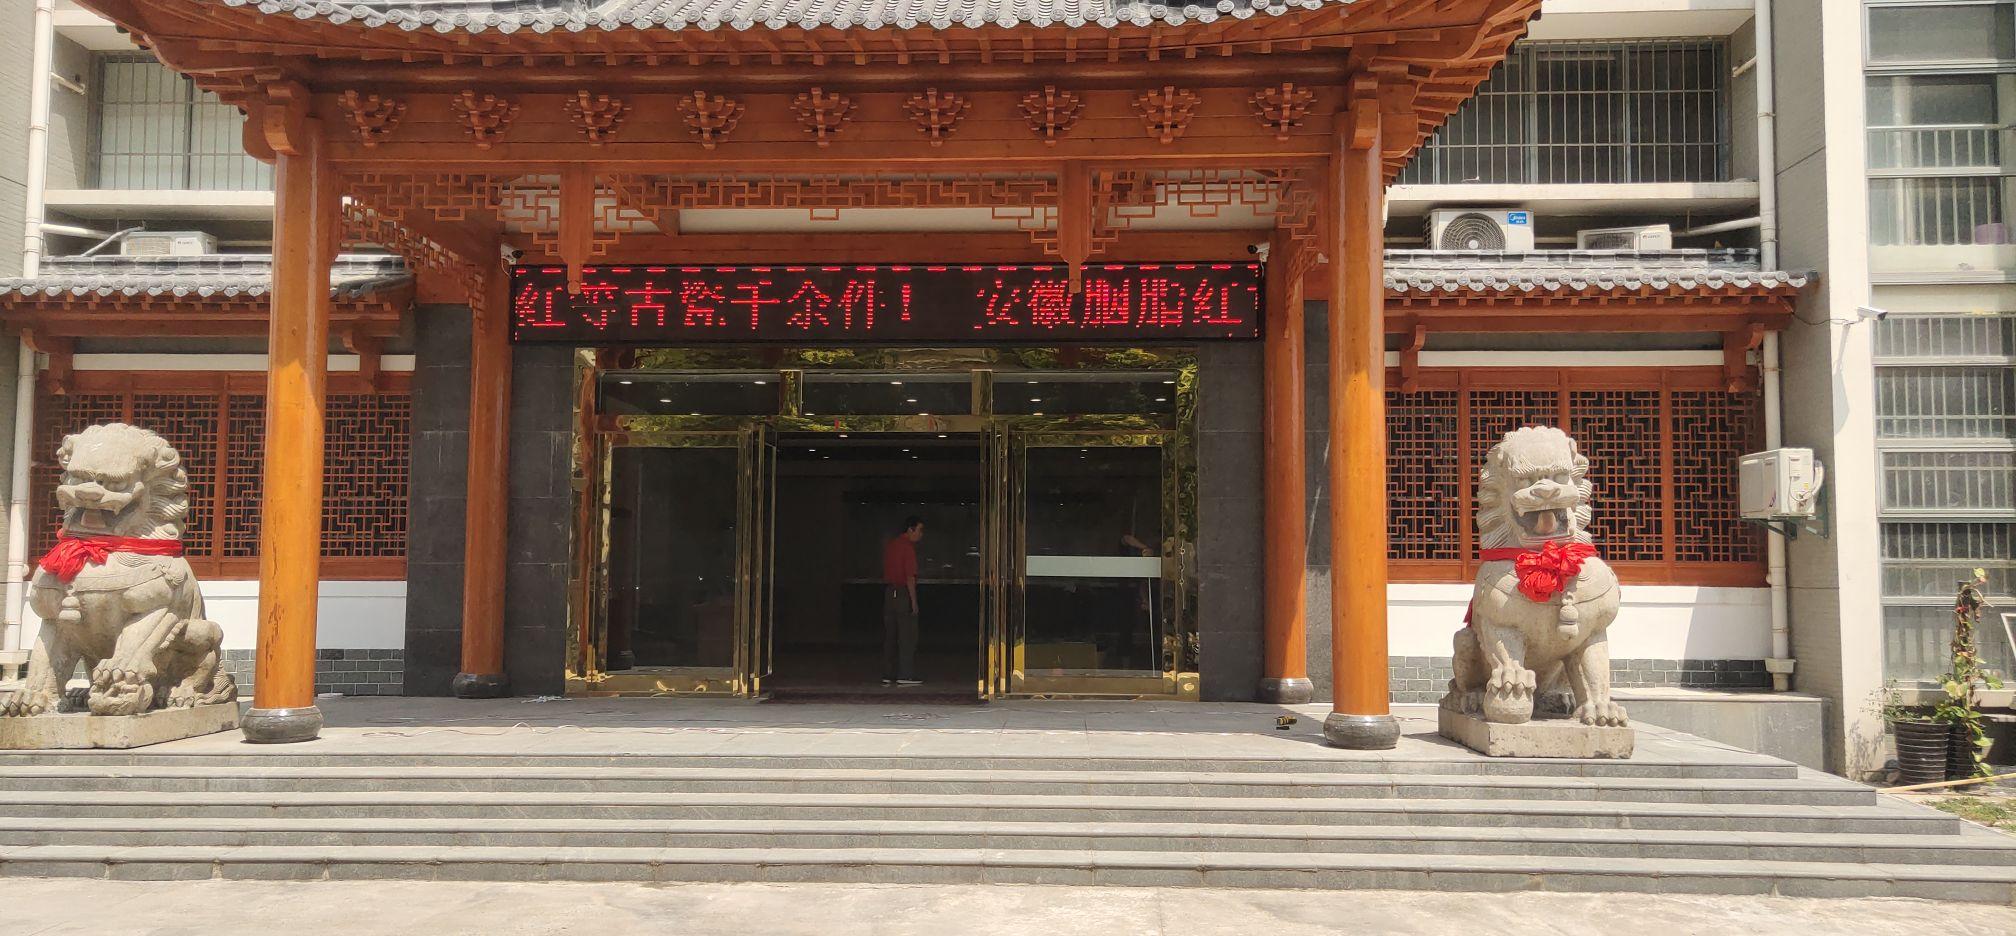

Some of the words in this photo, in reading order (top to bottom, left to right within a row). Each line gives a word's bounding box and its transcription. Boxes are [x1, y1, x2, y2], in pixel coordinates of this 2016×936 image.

[974, 279, 1257, 328] 安徽胭脂红
